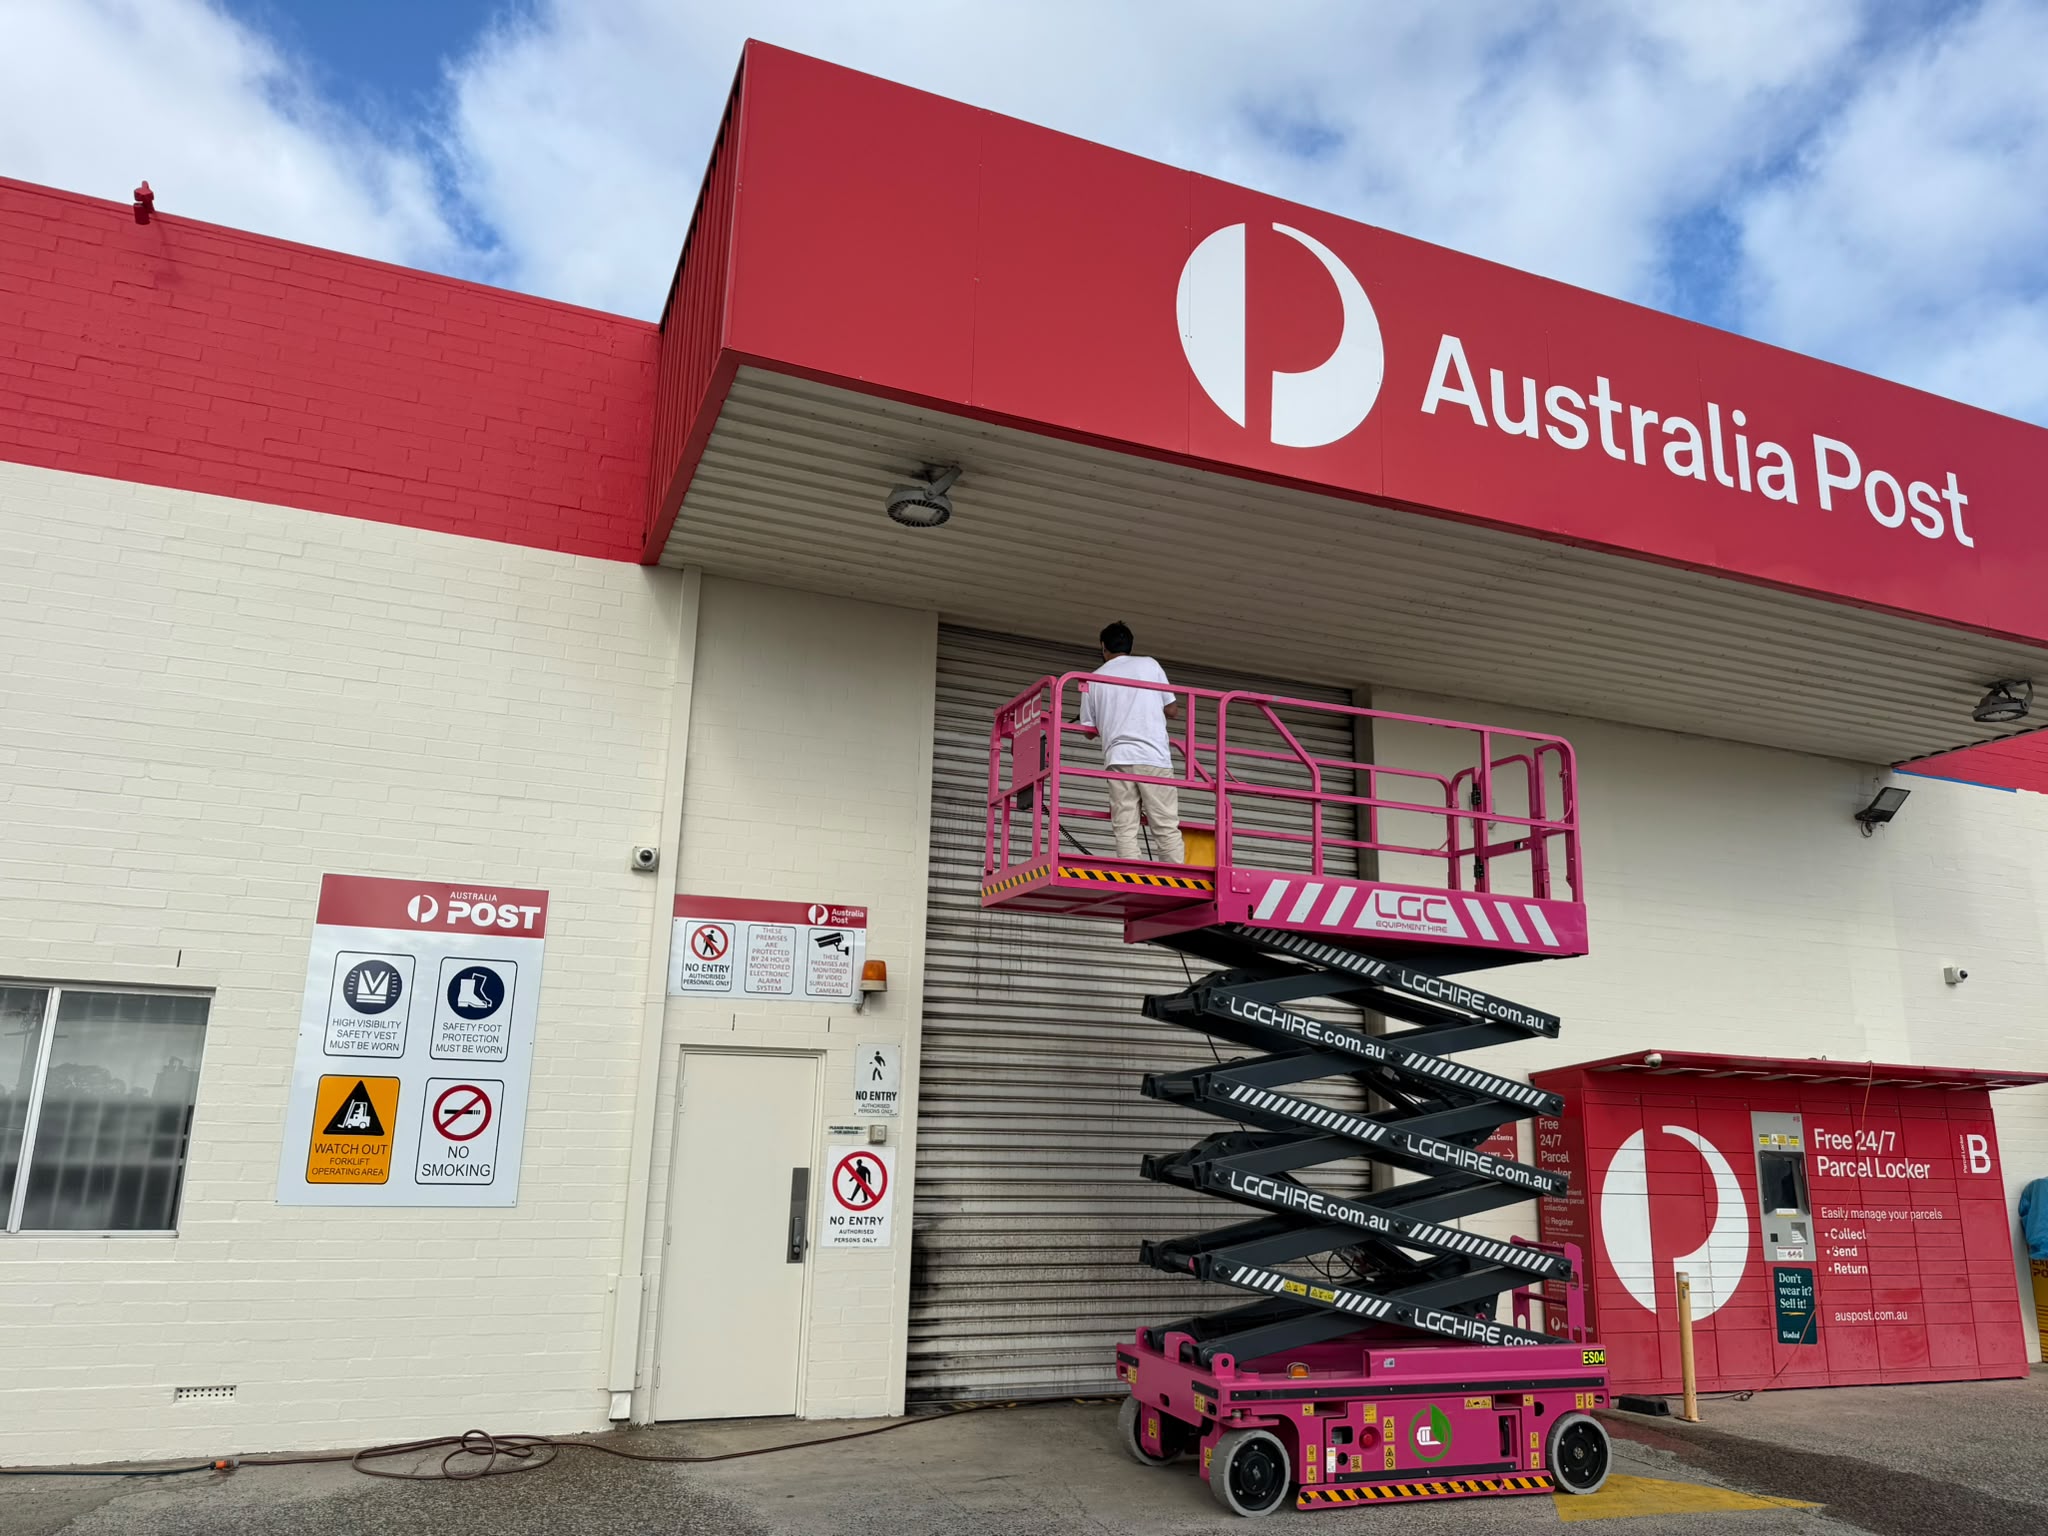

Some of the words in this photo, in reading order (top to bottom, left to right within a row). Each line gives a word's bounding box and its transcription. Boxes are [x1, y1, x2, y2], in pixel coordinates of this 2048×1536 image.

[1420, 333, 1799, 505] Australia
[1812, 432, 1975, 549] Post
[450, 891, 498, 902] AUSTRALIA
[832, 908, 864, 918] Australia
[1375, 892, 1448, 925] LGC
[446, 900, 542, 930] POST
[831, 915, 849, 925] Post
[763, 927, 782, 935] THESE
[1376, 920, 1427, 932] EQUIPMENT
[1428, 925, 1448, 934] HIRE
[756, 934, 788, 942] PREMISES
[752, 948, 790, 956] PROTECTED
[685, 963, 700, 972] NO
[701, 963, 730, 973] ENTRY
[750, 963, 791, 971] MONITORED
[812, 967, 847, 975] MONITORED
[750, 970, 790, 978] ELECTRONIC
[684, 978, 714, 986] PERSONNEL
[757, 977, 782, 985] ALARM
[809, 980, 849, 988] SURVEILLANCE
[1401, 969, 1545, 1030] LGCHIRE.com.au
[332, 1018, 356, 1028] HIGH
[357, 1019, 402, 1030] VISIBILITY
[442, 1022, 477, 1032] SAFETY
[477, 1023, 503, 1033] FOOT
[1230, 996, 1386, 1061] LGCHIRE.com.au
[336, 1029, 373, 1039] SAFETY
[373, 1030, 398, 1040] VEST
[442, 1032, 500, 1044] PROTECTION
[329, 1040, 356, 1049] MUST
[357, 1041, 370, 1050] BE
[371, 1042, 400, 1051] WORN
[435, 1043, 461, 1053] MUST
[462, 1044, 474, 1053] BE
[475, 1045, 503, 1054] WORN
[856, 1090, 868, 1101] NO
[869, 1091, 898, 1102] ENTRY
[1539, 1118, 1559, 1130] Free
[1540, 1133, 1562, 1148] 24/7
[1813, 1127, 1853, 1151] Free
[1855, 1129, 1896, 1155] 24/7
[314, 1143, 359, 1154] WATCH
[361, 1144, 388, 1155] OUT
[447, 1145, 470, 1159] NO
[1966, 1134, 1992, 1174] B
[329, 1157, 370, 1166] FORKLIFT
[1406, 1133, 1553, 1192] LGCHIRE.com.au
[1540, 1150, 1570, 1163] Parcel
[311, 1167, 360, 1176] OPERATING
[361, 1168, 384, 1176] AREA
[421, 1162, 491, 1178] SMOKING
[1817, 1156, 1873, 1179] Parcel
[1876, 1157, 1931, 1179] Locker
[1230, 1170, 1390, 1233] LGCHIRE.com.au
[1821, 1206, 1849, 1221] Easily
[1850, 1209, 1887, 1222] manage
[1888, 1210, 1908, 1222] your
[1910, 1208, 1943, 1223] parcels
[829, 1216, 845, 1225] NO
[849, 1216, 884, 1226] ENTRY
[1830, 1228, 1867, 1240] Collect
[1831, 1245, 1858, 1257] Send
[1833, 1262, 1868, 1274] Return
[1778, 1272, 1802, 1284] Don't
[1779, 1287, 1800, 1296] wear
[1801, 1285, 1813, 1296] it?
[1780, 1297, 1796, 1309] Sell
[1797, 1298, 1807, 1309] it!
[1834, 1309, 1908, 1323] auspost.com.au
[1583, 1351, 1604, 1364] ES04
